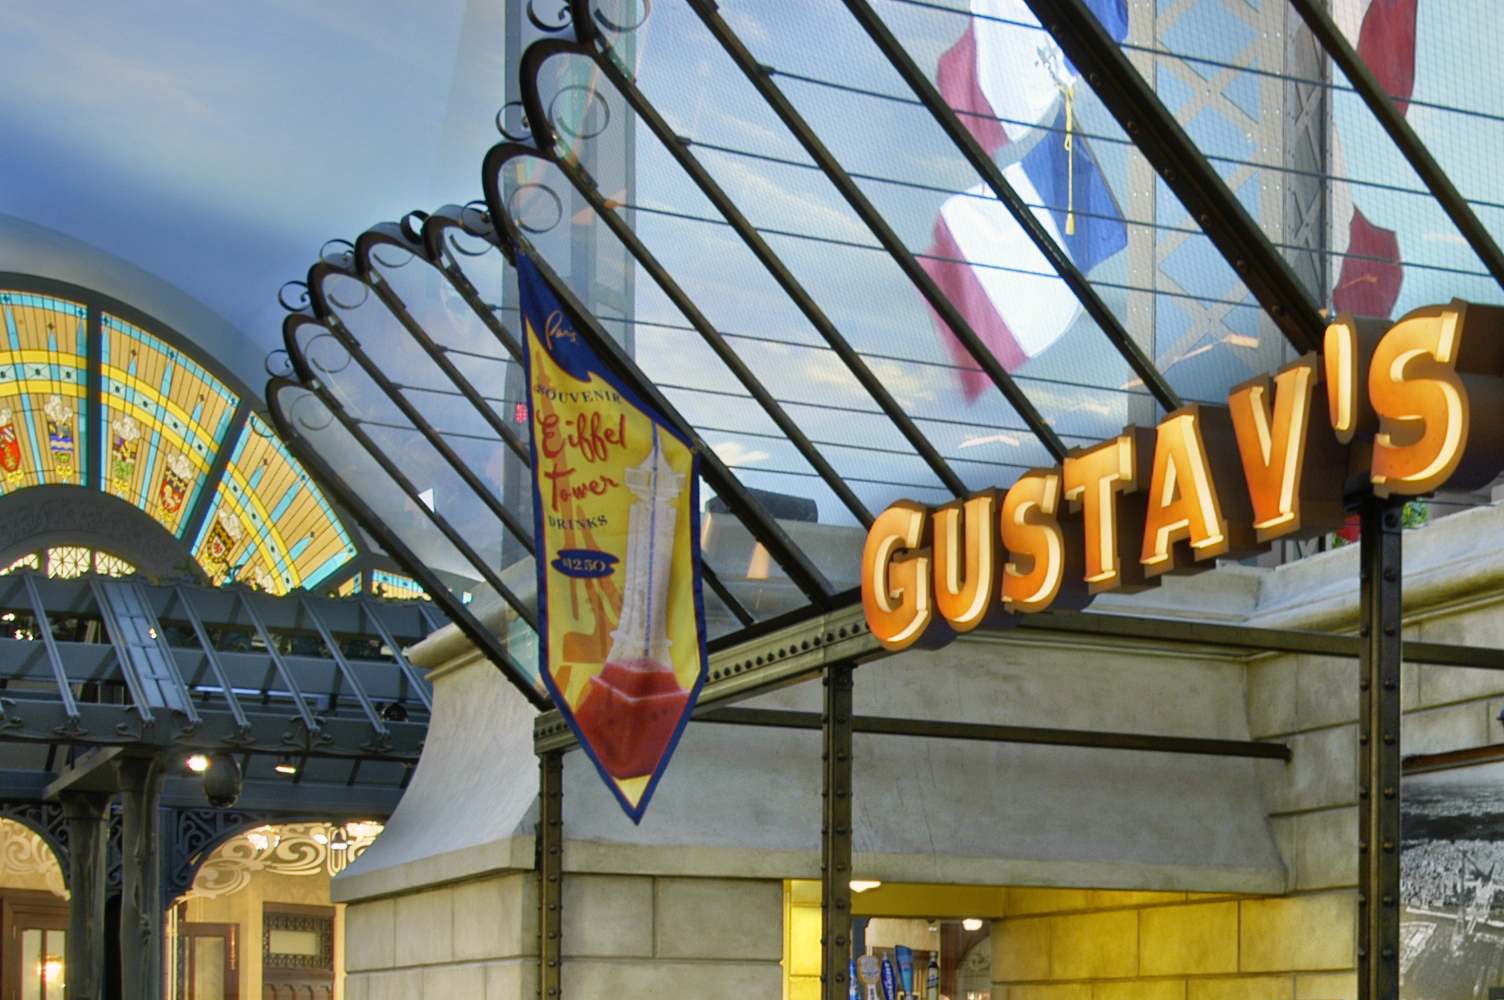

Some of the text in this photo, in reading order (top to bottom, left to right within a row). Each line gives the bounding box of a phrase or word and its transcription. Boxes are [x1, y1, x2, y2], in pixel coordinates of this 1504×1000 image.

[544, 309, 577, 351] Paris
[536, 383, 621, 404] SOUVENIR
[536, 410, 627, 463] Eiffel
[861, 299, 1474, 652] GUSTAV'S
[548, 514, 608, 530] DRINKS
